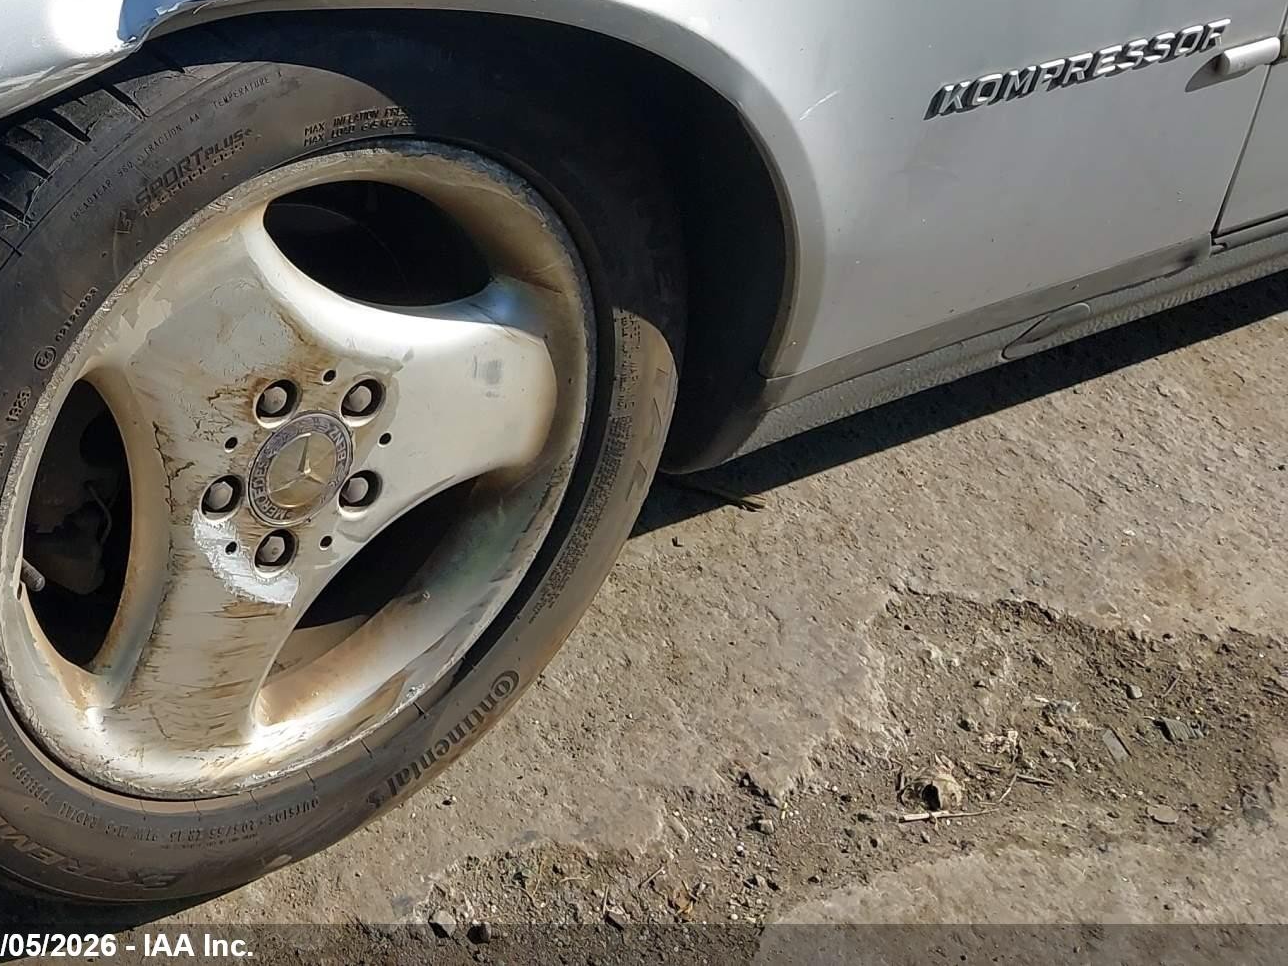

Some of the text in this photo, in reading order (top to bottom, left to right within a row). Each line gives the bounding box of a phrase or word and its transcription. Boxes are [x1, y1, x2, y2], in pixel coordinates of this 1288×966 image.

[924, 18, 1232, 120] KOMPRESSOR
[142, 124, 183, 154] TRACTION
[212, 77, 271, 109] TEMPERATURE
[303, 133, 324, 148] MAX
[304, 122, 326, 137] MAX
[326, 421, 348, 465] BENZ
[251, 459, 292, 522] MERCEDES
[384, 669, 521, 799] Continental
